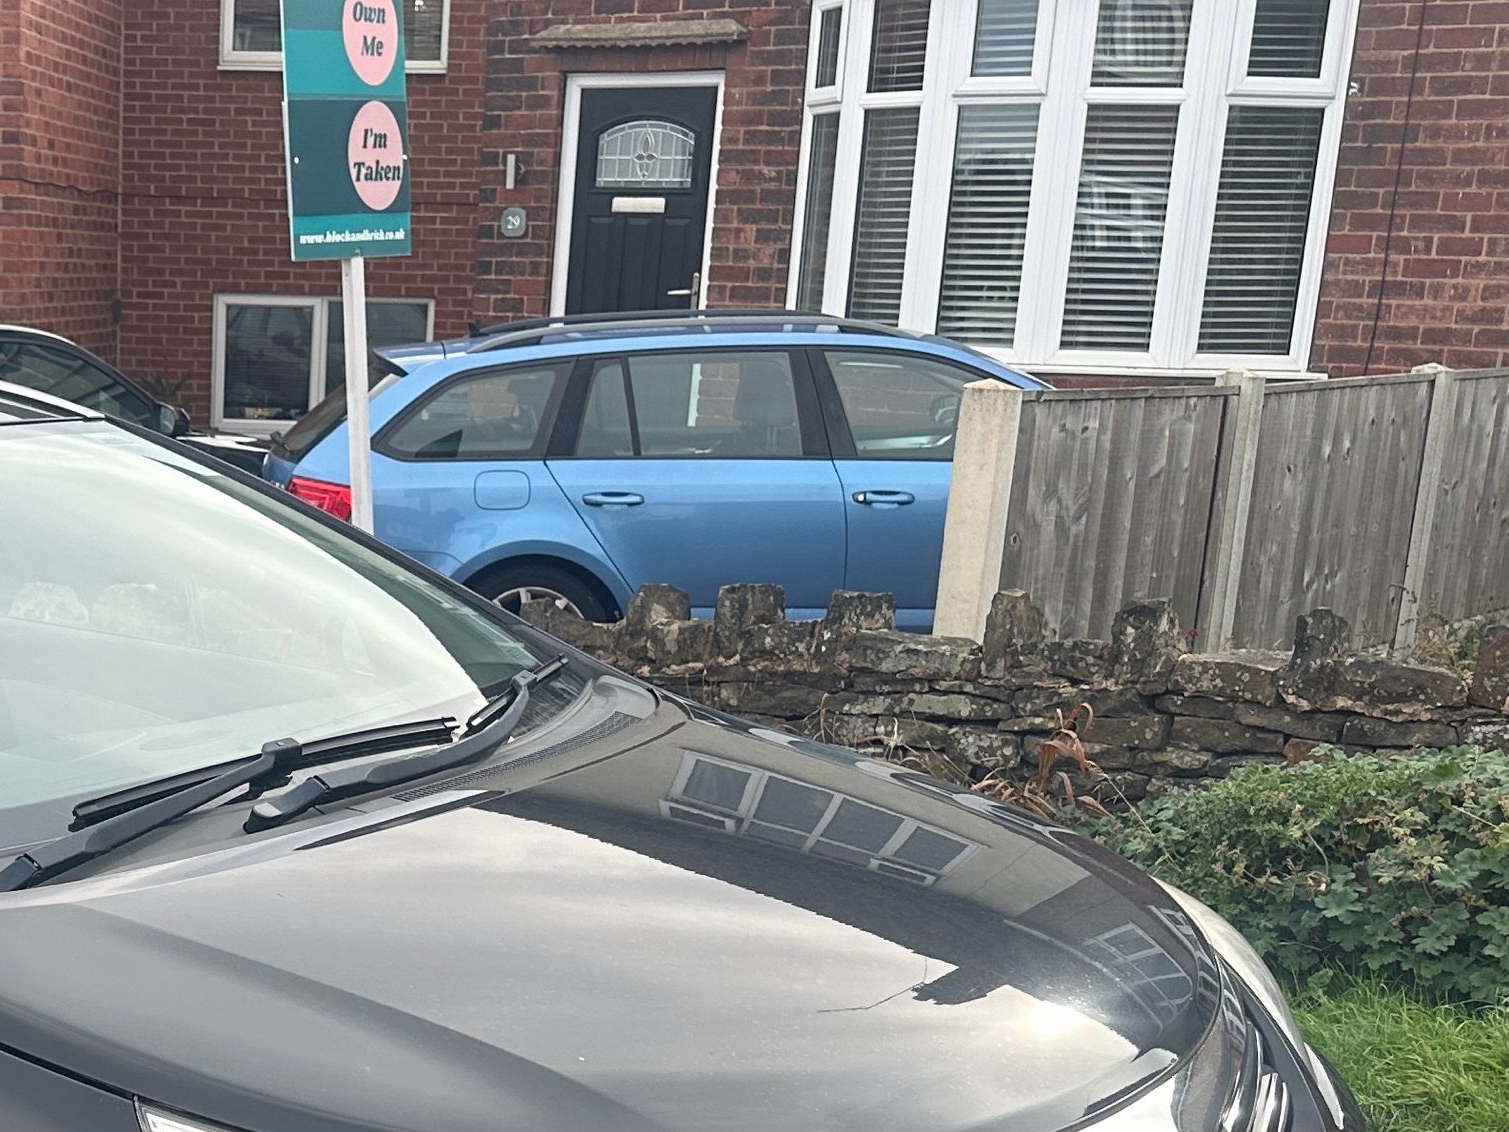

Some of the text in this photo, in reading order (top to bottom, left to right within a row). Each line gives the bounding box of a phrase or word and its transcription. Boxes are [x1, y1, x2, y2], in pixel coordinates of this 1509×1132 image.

[353, 1, 386, 24] Own
[361, 35, 384, 57] Me
[362, 128, 388, 149] I'm
[353, 160, 401, 182] Taken
